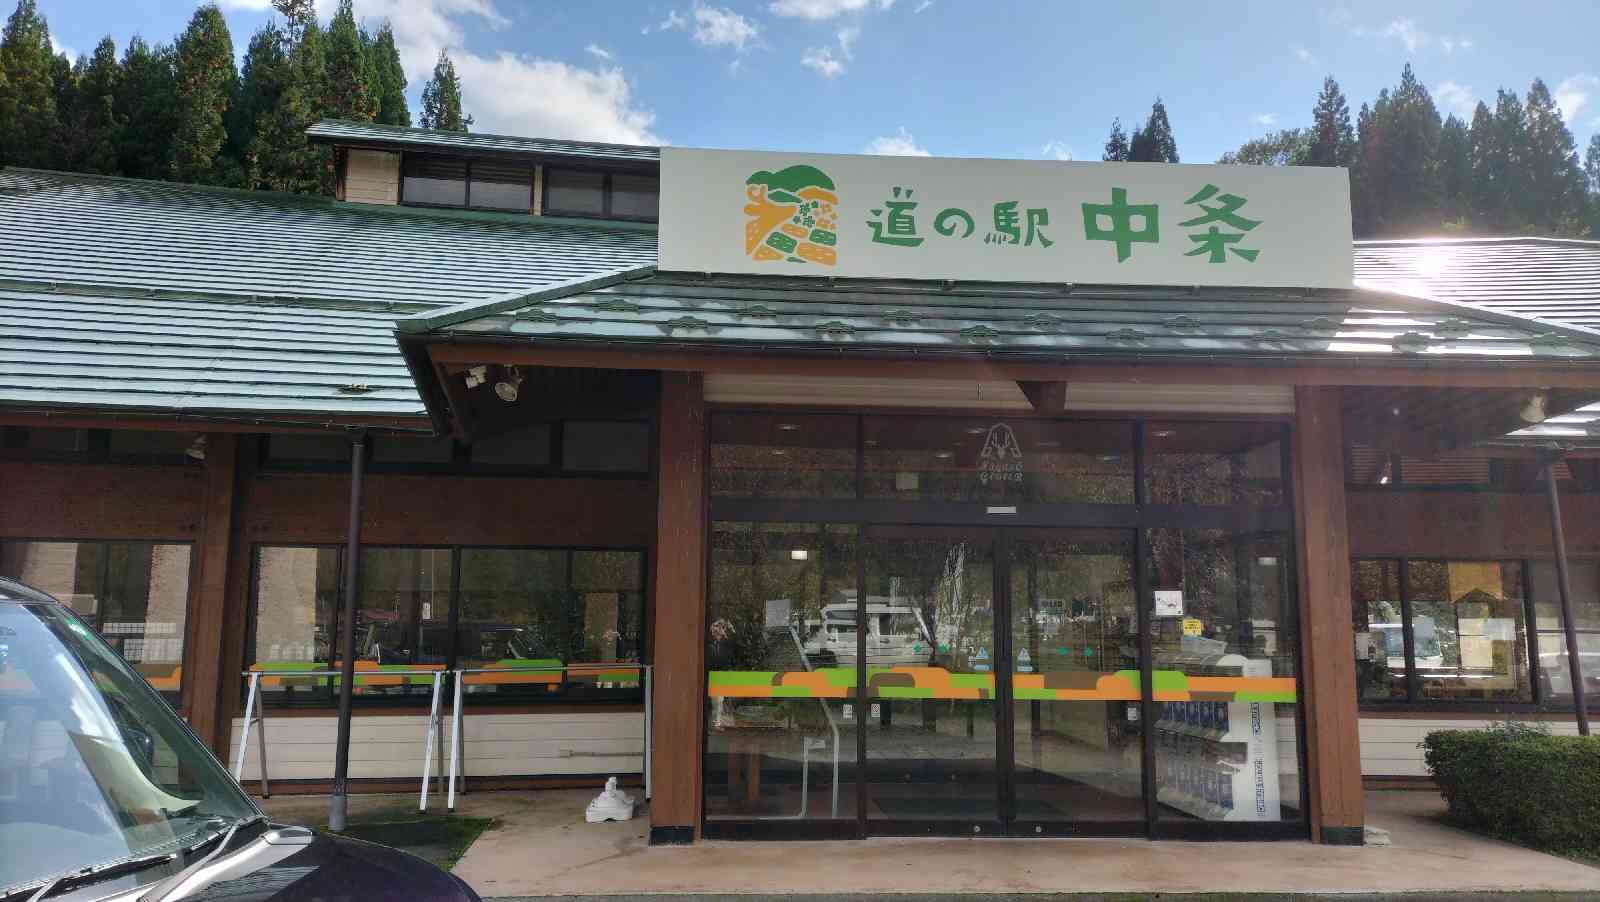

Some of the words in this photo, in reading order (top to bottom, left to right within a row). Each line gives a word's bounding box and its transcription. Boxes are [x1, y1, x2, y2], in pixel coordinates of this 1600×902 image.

[866, 187, 1054, 248] 道の駅
[1082, 184, 1263, 264] 中条
